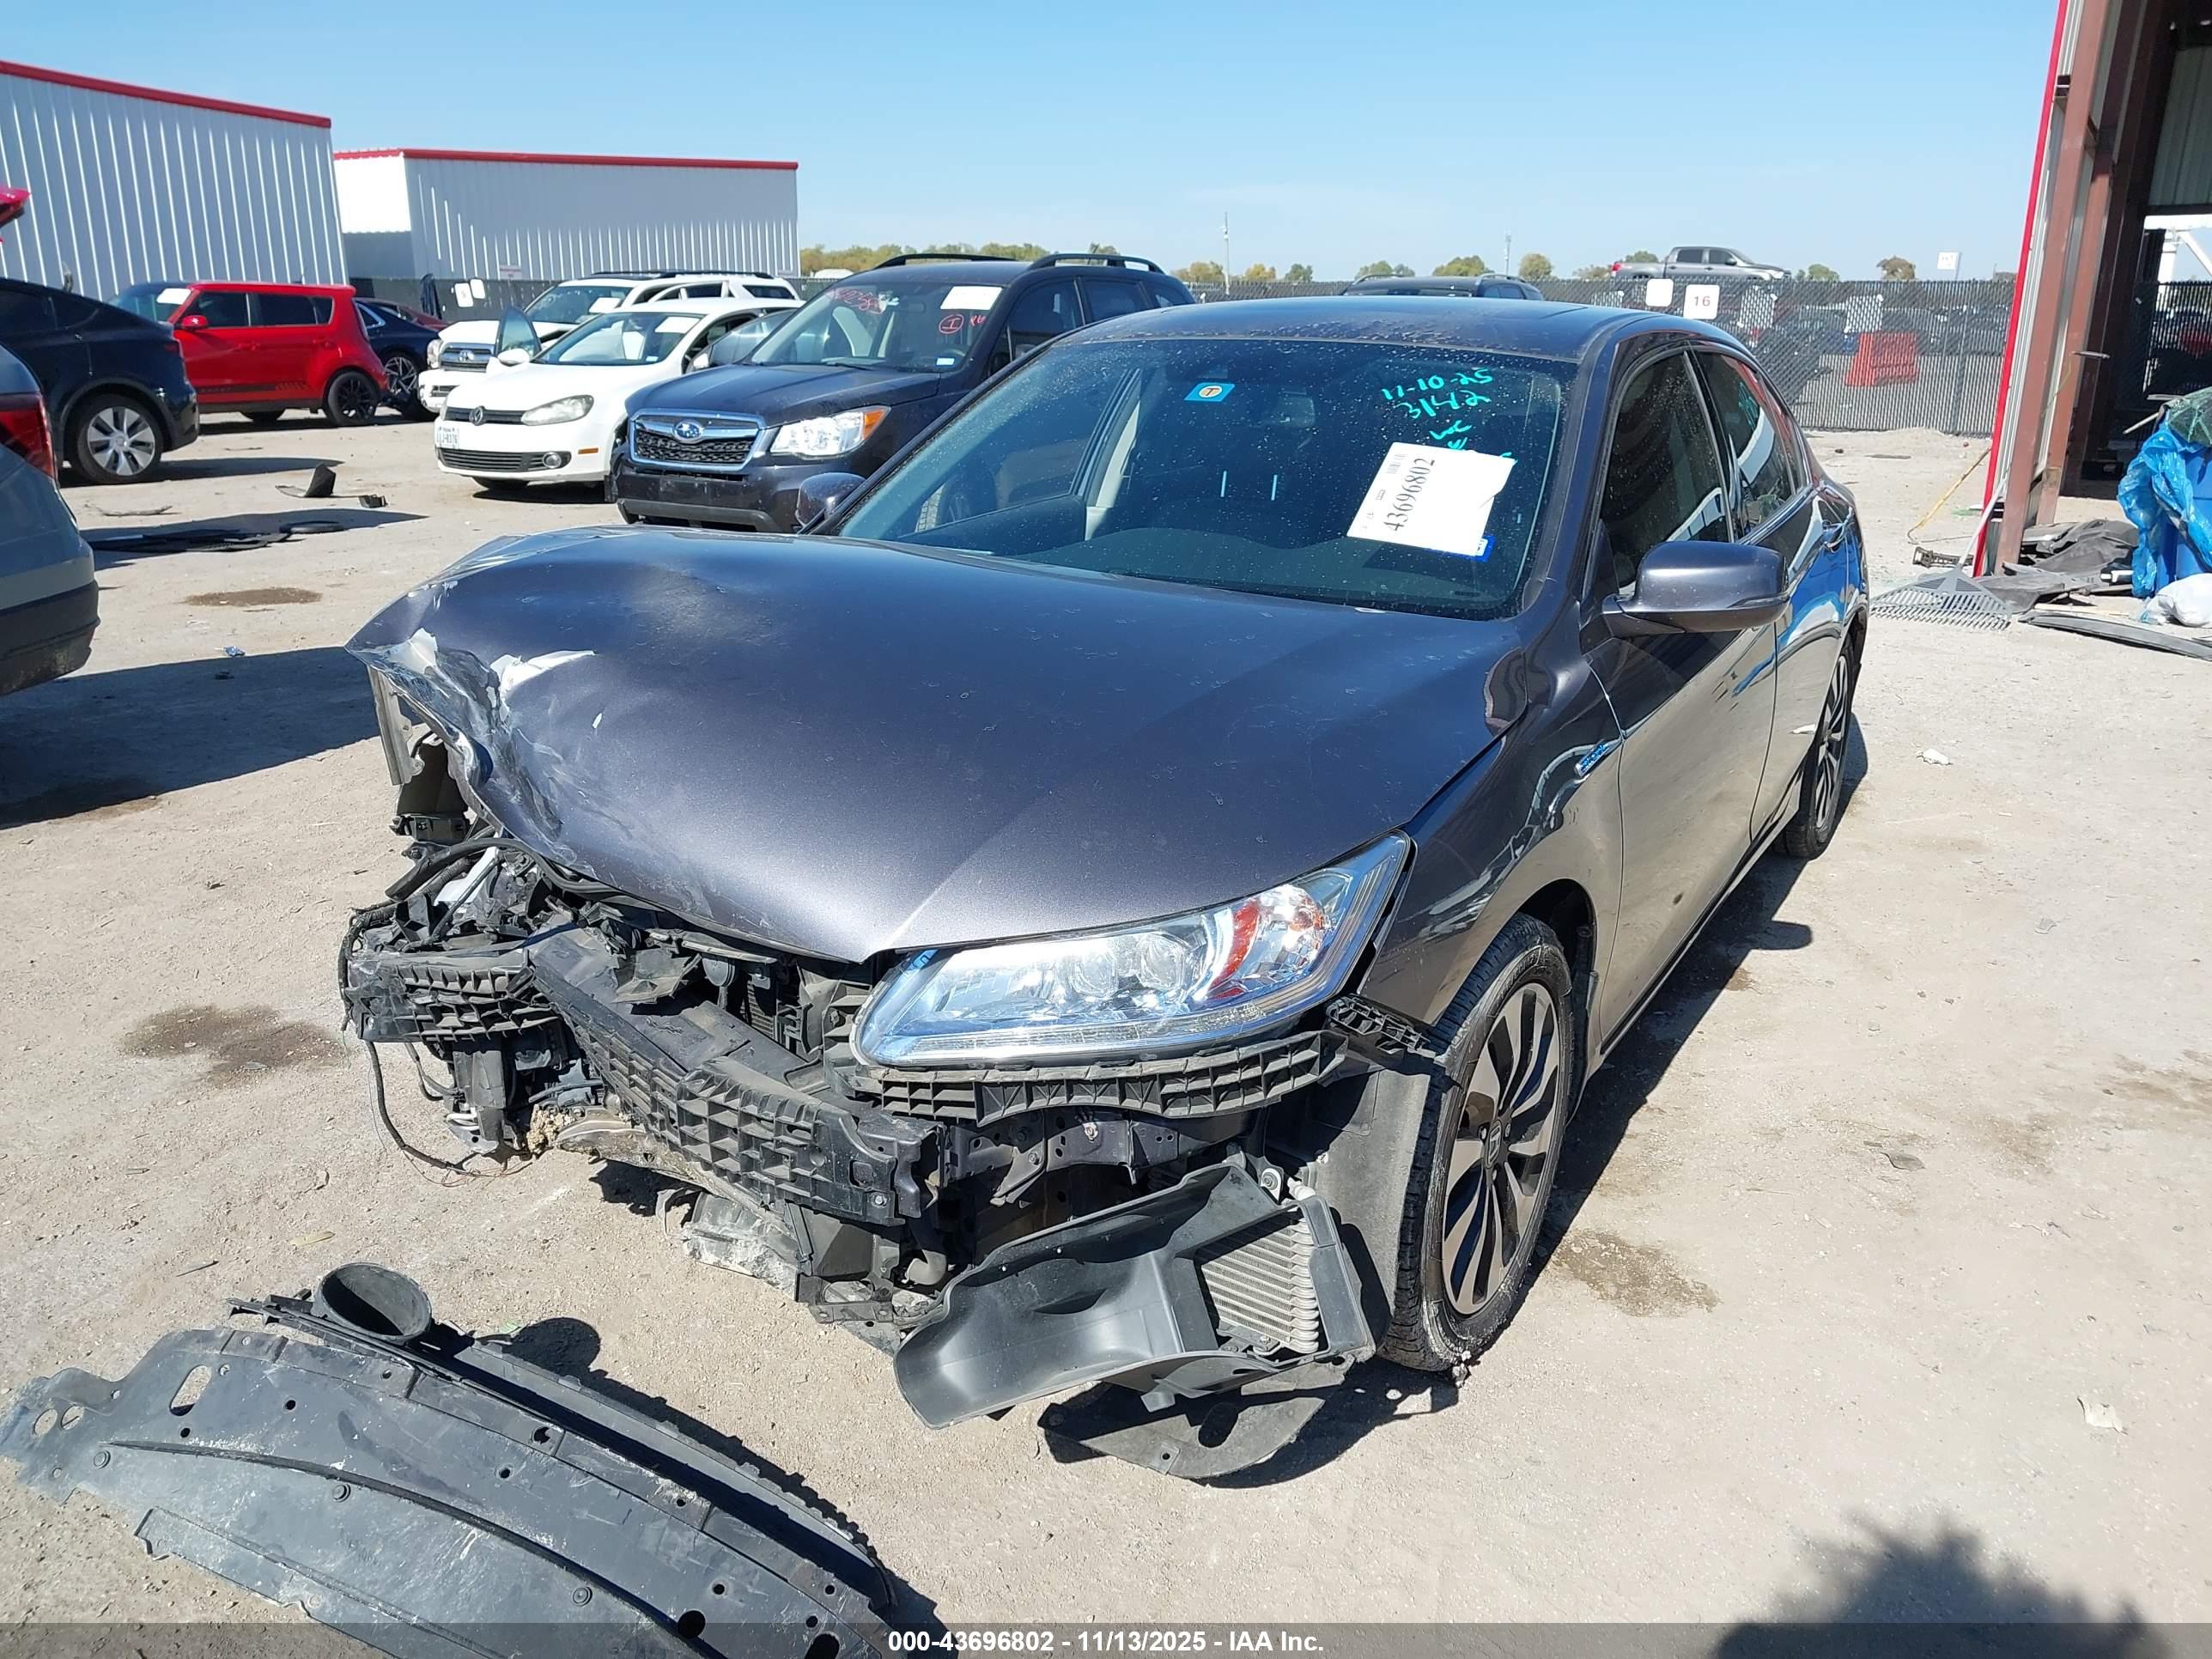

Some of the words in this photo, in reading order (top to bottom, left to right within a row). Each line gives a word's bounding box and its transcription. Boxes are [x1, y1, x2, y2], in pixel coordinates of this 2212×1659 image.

[1693, 295, 1711, 307] 16
[1393, 390, 1492, 418] 3142
[1383, 458, 1435, 532] 43696802
